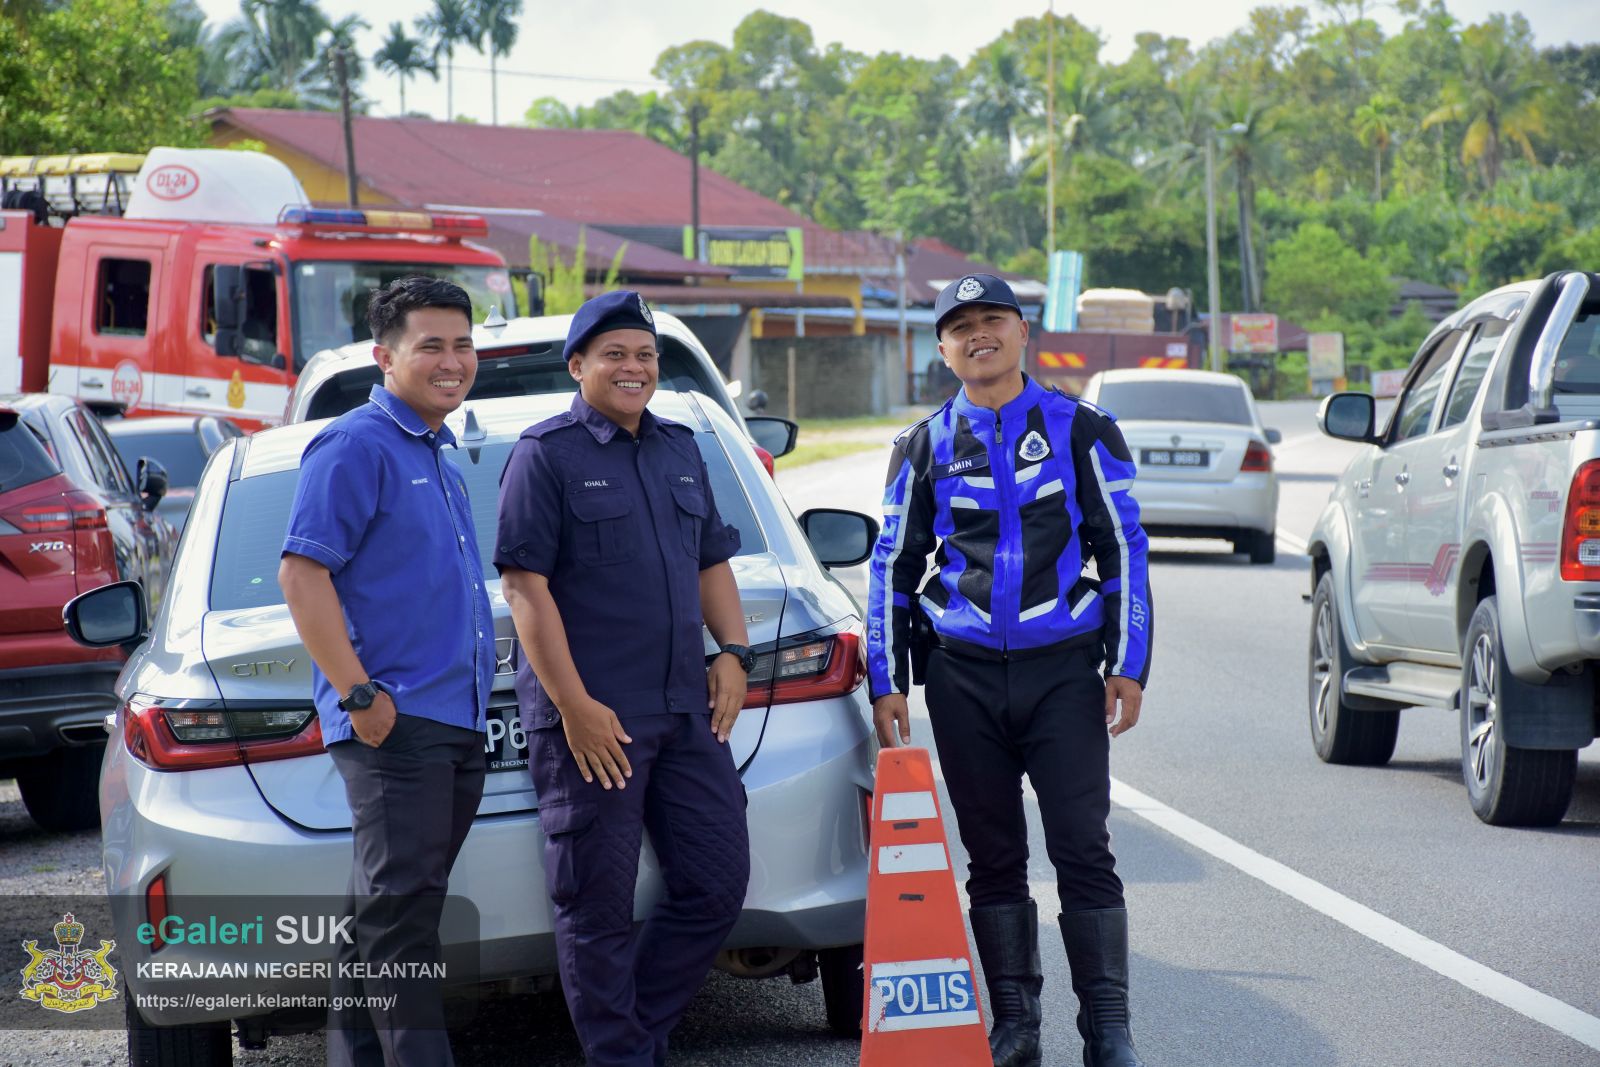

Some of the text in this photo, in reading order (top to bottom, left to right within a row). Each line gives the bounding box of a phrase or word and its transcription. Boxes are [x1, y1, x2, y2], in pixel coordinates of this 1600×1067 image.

[156, 173, 188, 188] D1-24
[948, 459, 973, 473] AMIN
[29, 541, 65, 553] X70
[1131, 593, 1146, 631] JSPT
[231, 658, 296, 677] CITY
[875, 973, 969, 1014] POLIS
